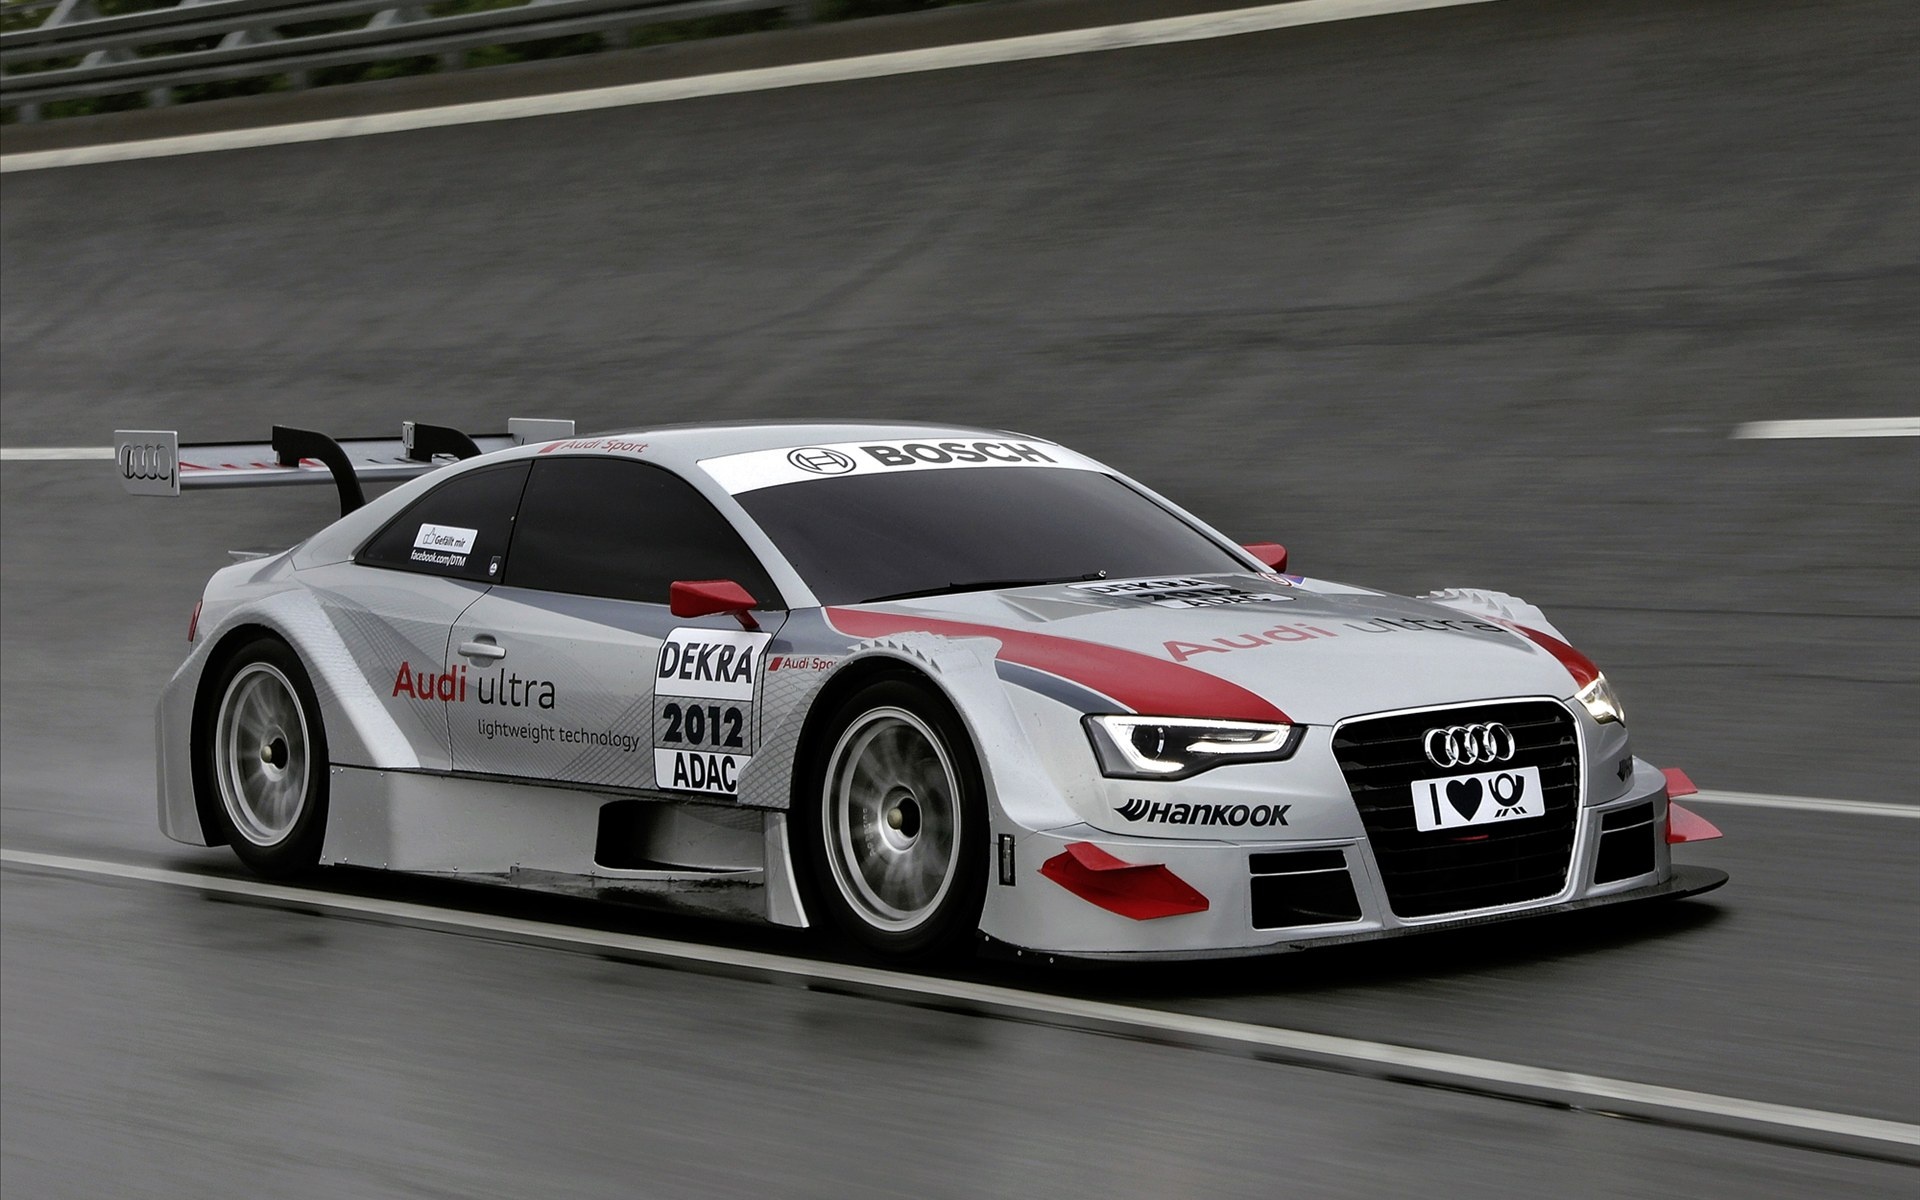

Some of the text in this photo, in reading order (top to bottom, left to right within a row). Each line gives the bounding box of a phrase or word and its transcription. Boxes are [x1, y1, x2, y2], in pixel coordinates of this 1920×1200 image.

[601, 440, 648, 453] Sport
[861, 442, 1058, 465] BOSCH
[454, 538, 466, 547] mir
[410, 550, 466, 566] facebook.com/DTM
[1090, 577, 1218, 594] DEKRA
[1162, 616, 1508, 662] Audi ultra
[658, 641, 755, 685] DEKRA
[783, 657, 810, 670] Audi
[392, 661, 557, 710] Audi ultra
[477, 718, 641, 753] lightweight technology
[662, 702, 744, 748] 2012
[673, 752, 738, 794] ADAC
